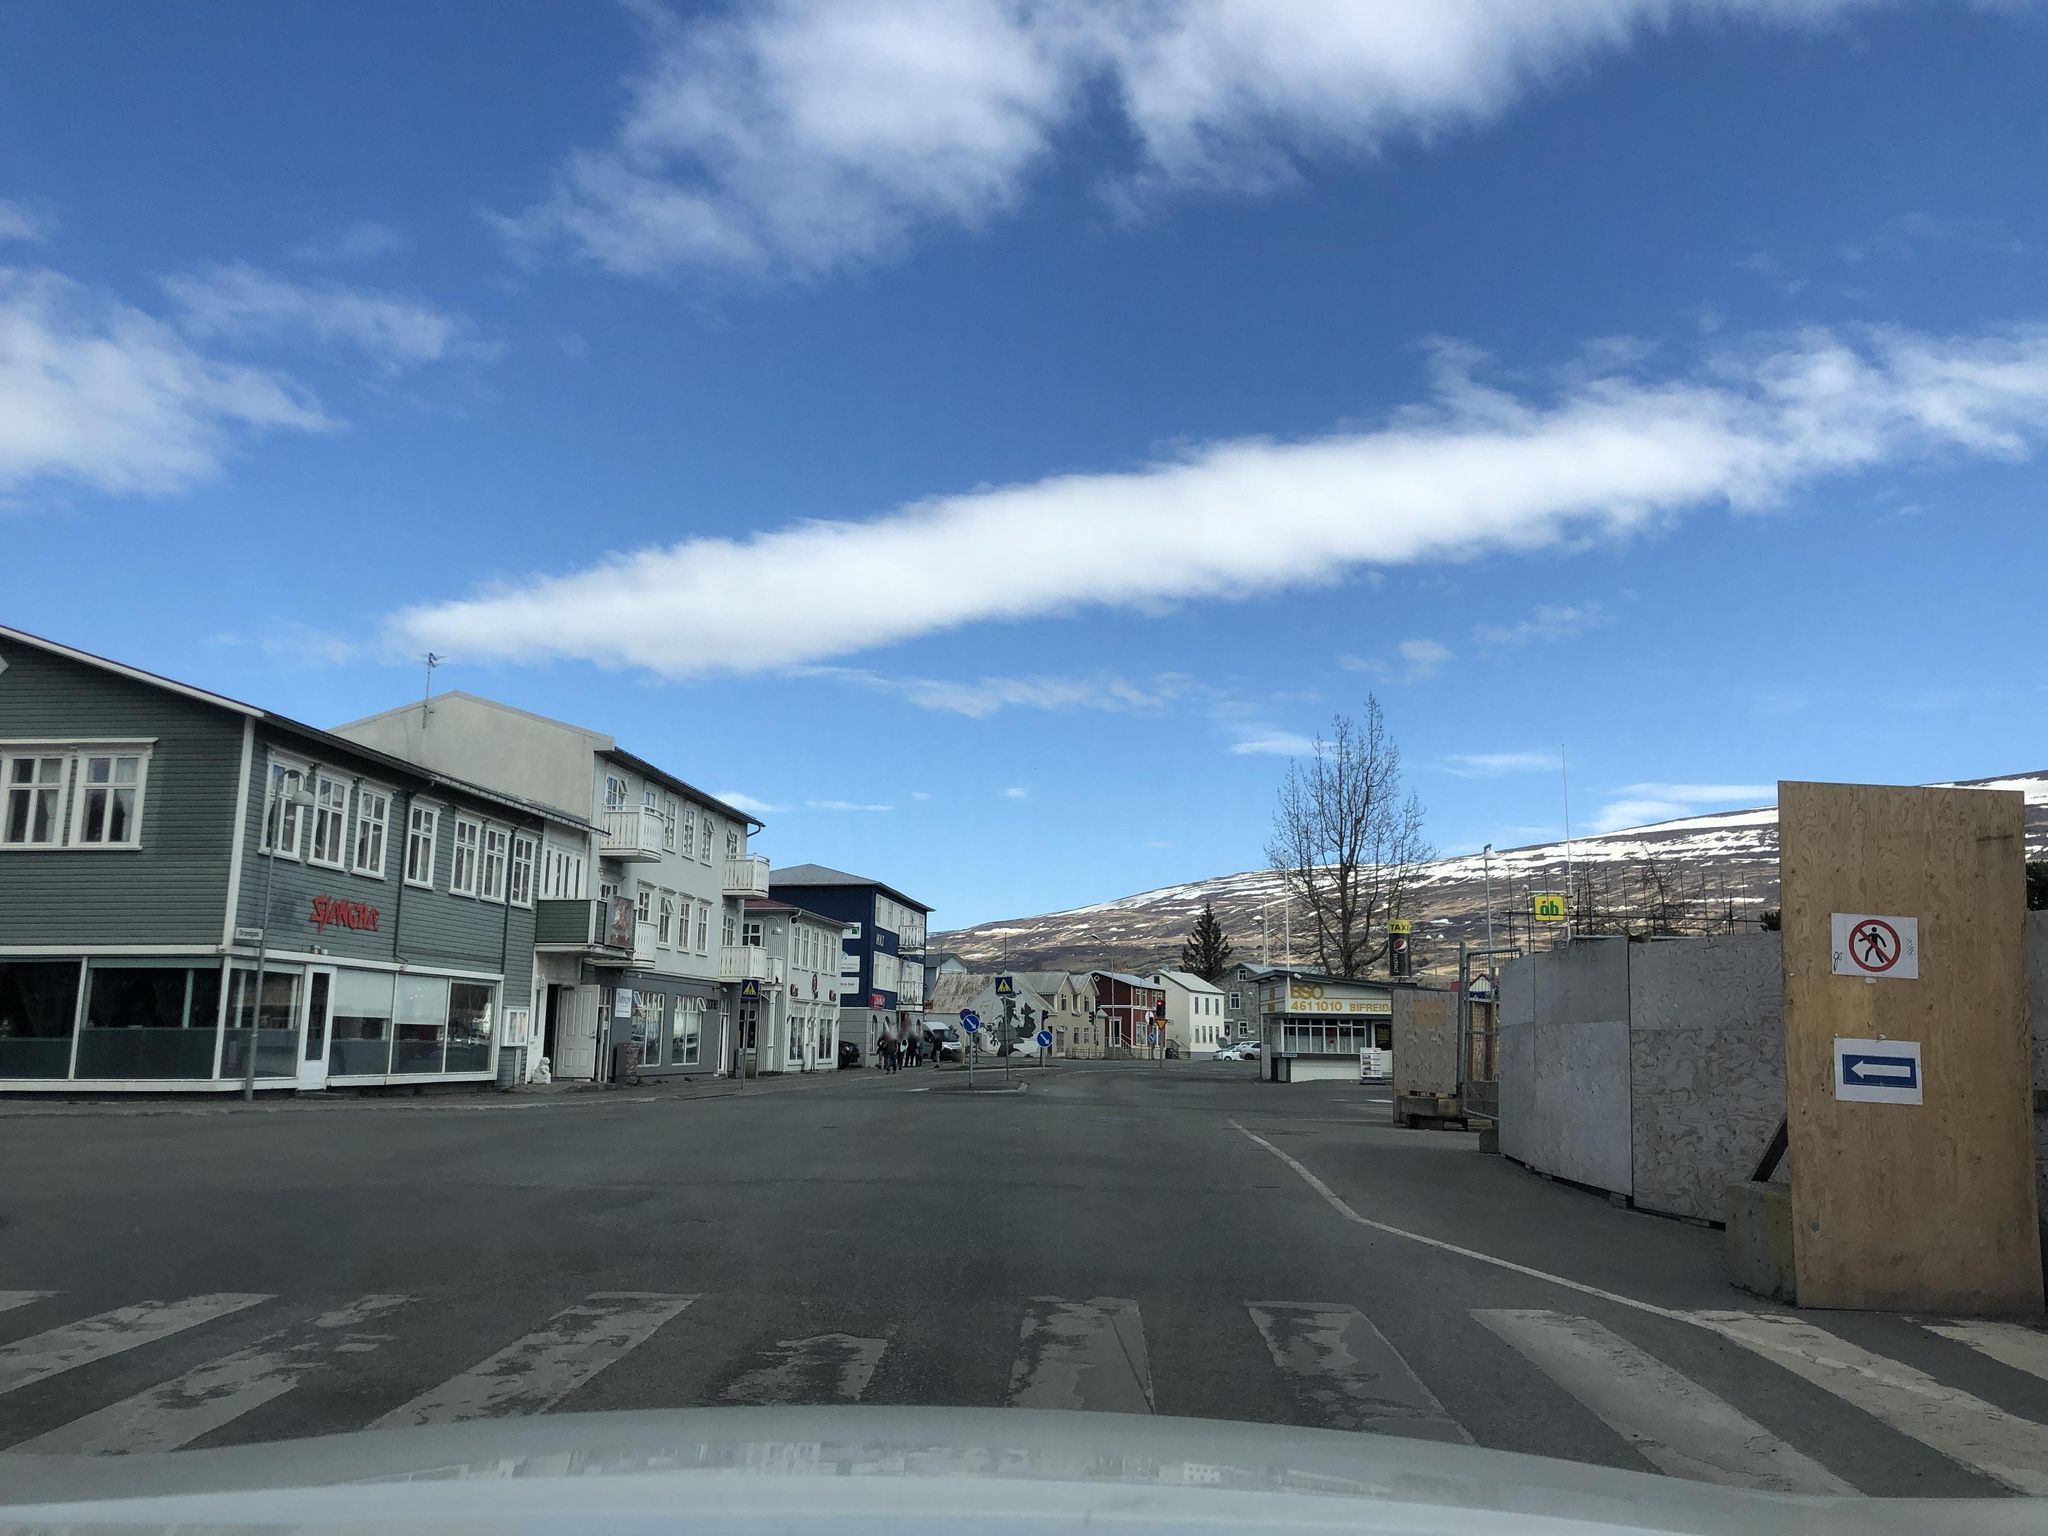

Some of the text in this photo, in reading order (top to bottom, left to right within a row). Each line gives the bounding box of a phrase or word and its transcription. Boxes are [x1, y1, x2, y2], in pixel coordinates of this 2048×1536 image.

[1290, 985, 1325, 999] BSO
[1291, 1001, 1312, 1011] 461
[1315, 1001, 1343, 1011] 1010
